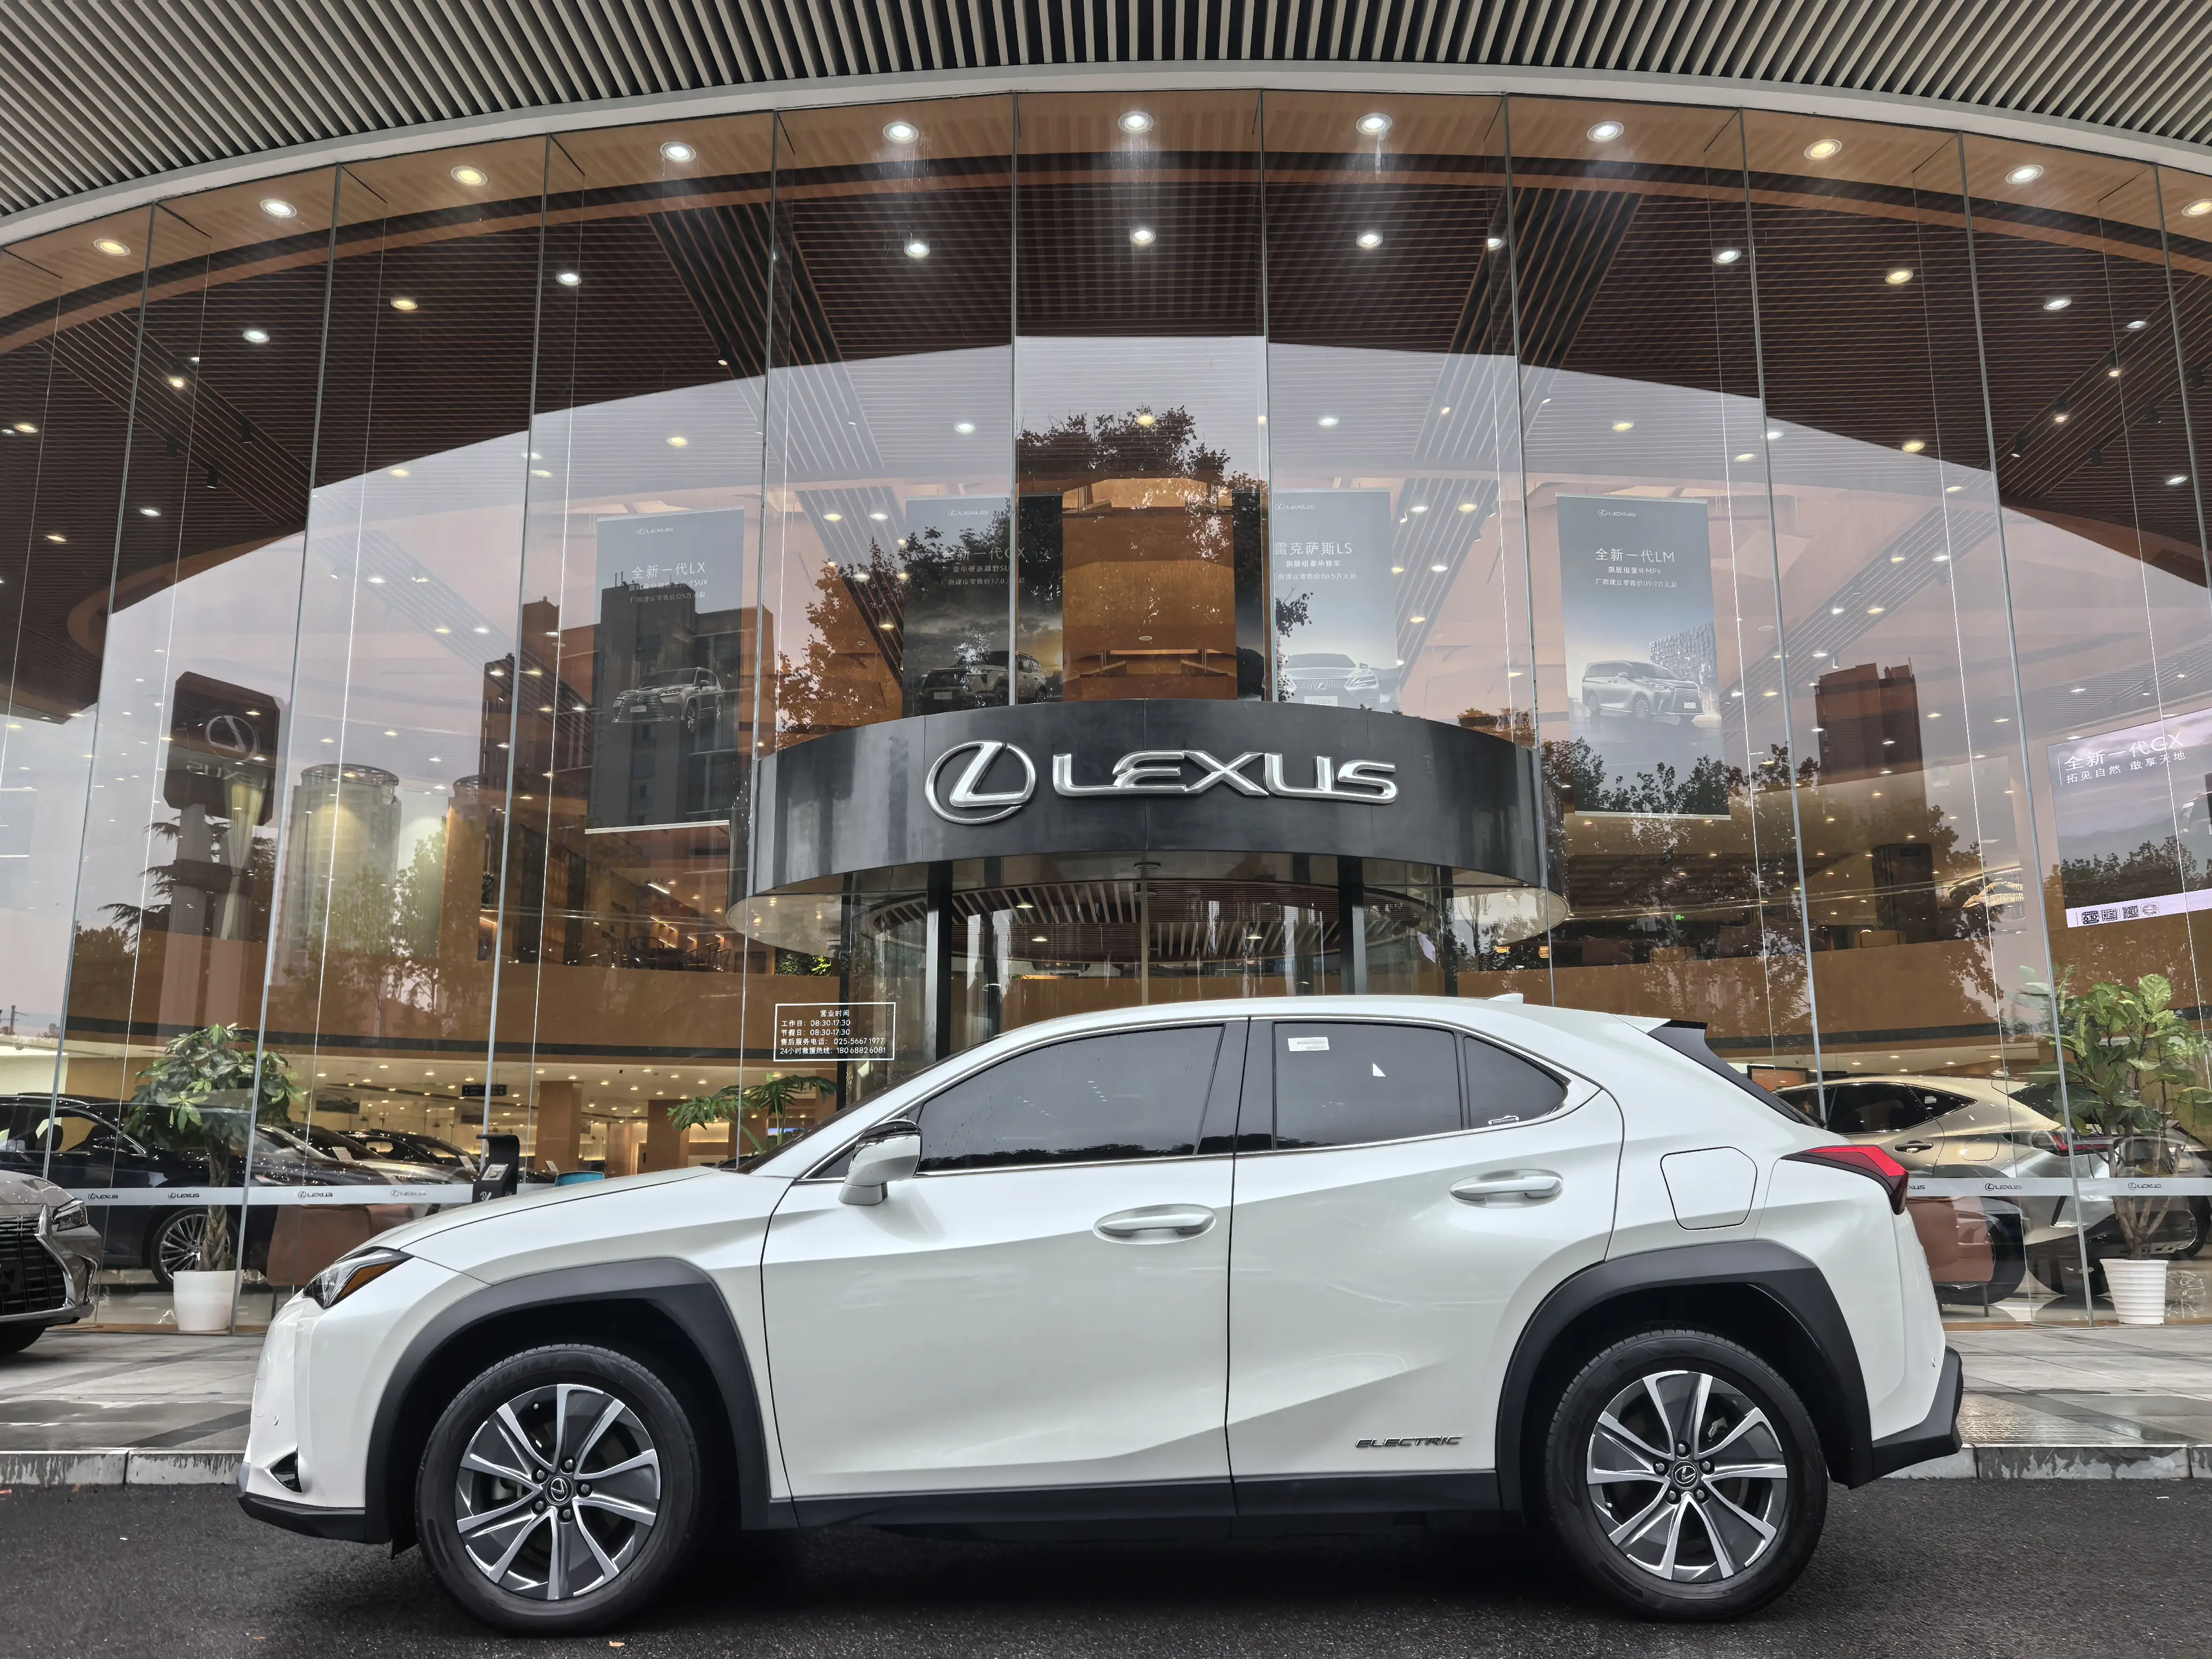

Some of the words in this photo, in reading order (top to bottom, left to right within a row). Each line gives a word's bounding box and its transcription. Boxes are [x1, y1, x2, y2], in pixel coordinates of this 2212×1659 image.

[1274, 542, 1352, 555] 雷克萨斯LS
[1595, 548, 1675, 563] 全新一代LM
[631, 562, 706, 579] 全新一代LX
[2064, 732, 2183, 771] 全新一代GX
[2066, 765, 2122, 784] 拓见自然
[2129, 750, 2186, 771] 敢享天地
[1052, 750, 1399, 804] LEXUS
[820, 1009, 850, 1017] 营业时间
[1355, 1435, 1463, 1448] ELECTRIC
